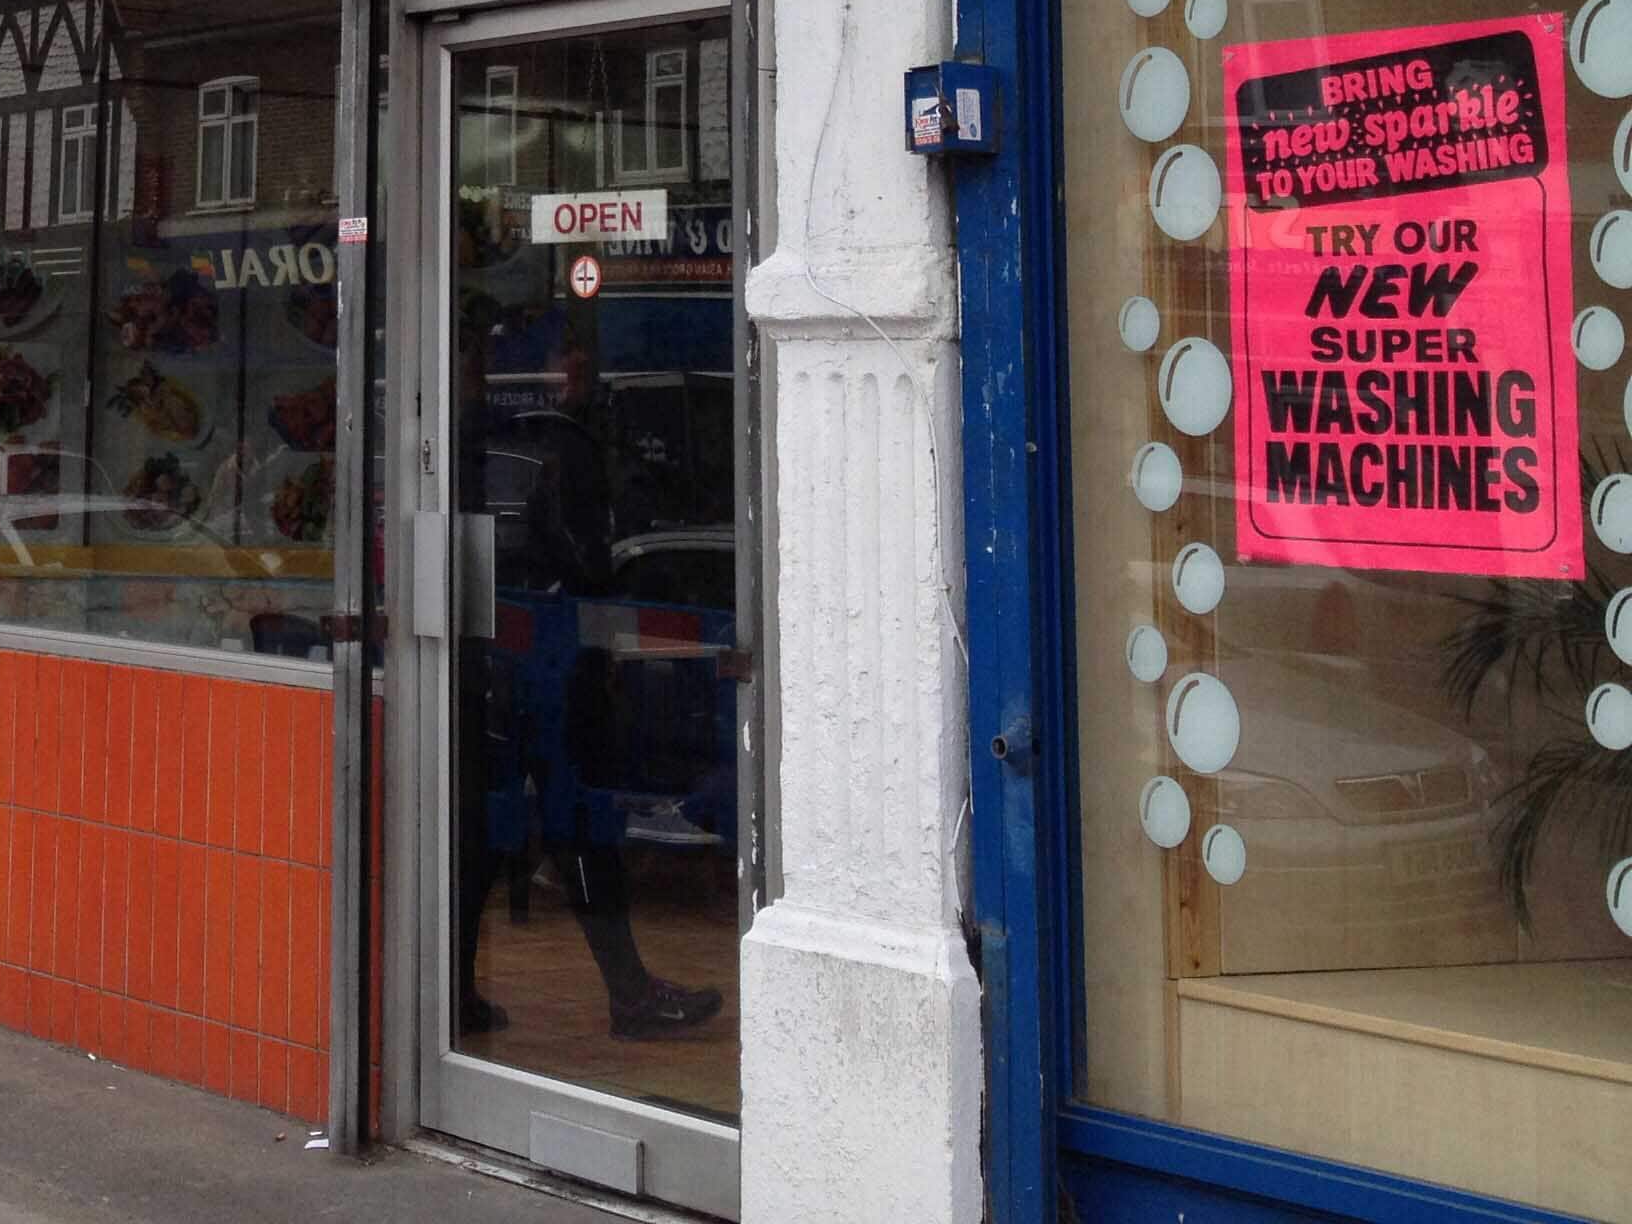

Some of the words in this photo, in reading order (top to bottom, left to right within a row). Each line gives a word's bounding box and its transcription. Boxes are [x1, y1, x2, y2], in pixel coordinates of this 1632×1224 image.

[1320, 59, 1434, 107] BRING
[1264, 120, 1351, 160] new
[1364, 87, 1520, 146] sparkle
[1256, 167, 1294, 200] TO
[1296, 156, 1380, 195] YOUR
[1386, 133, 1535, 182] WASHING
[554, 202, 642, 234] OPEN
[1306, 224, 1383, 258] TRY
[1393, 219, 1478, 254] OUR
[1305, 263, 1479, 321] NEW
[1311, 327, 1478, 364] SUPER
[1261, 369, 1536, 439] WASHING
[1265, 442, 1540, 515] MACHINES
